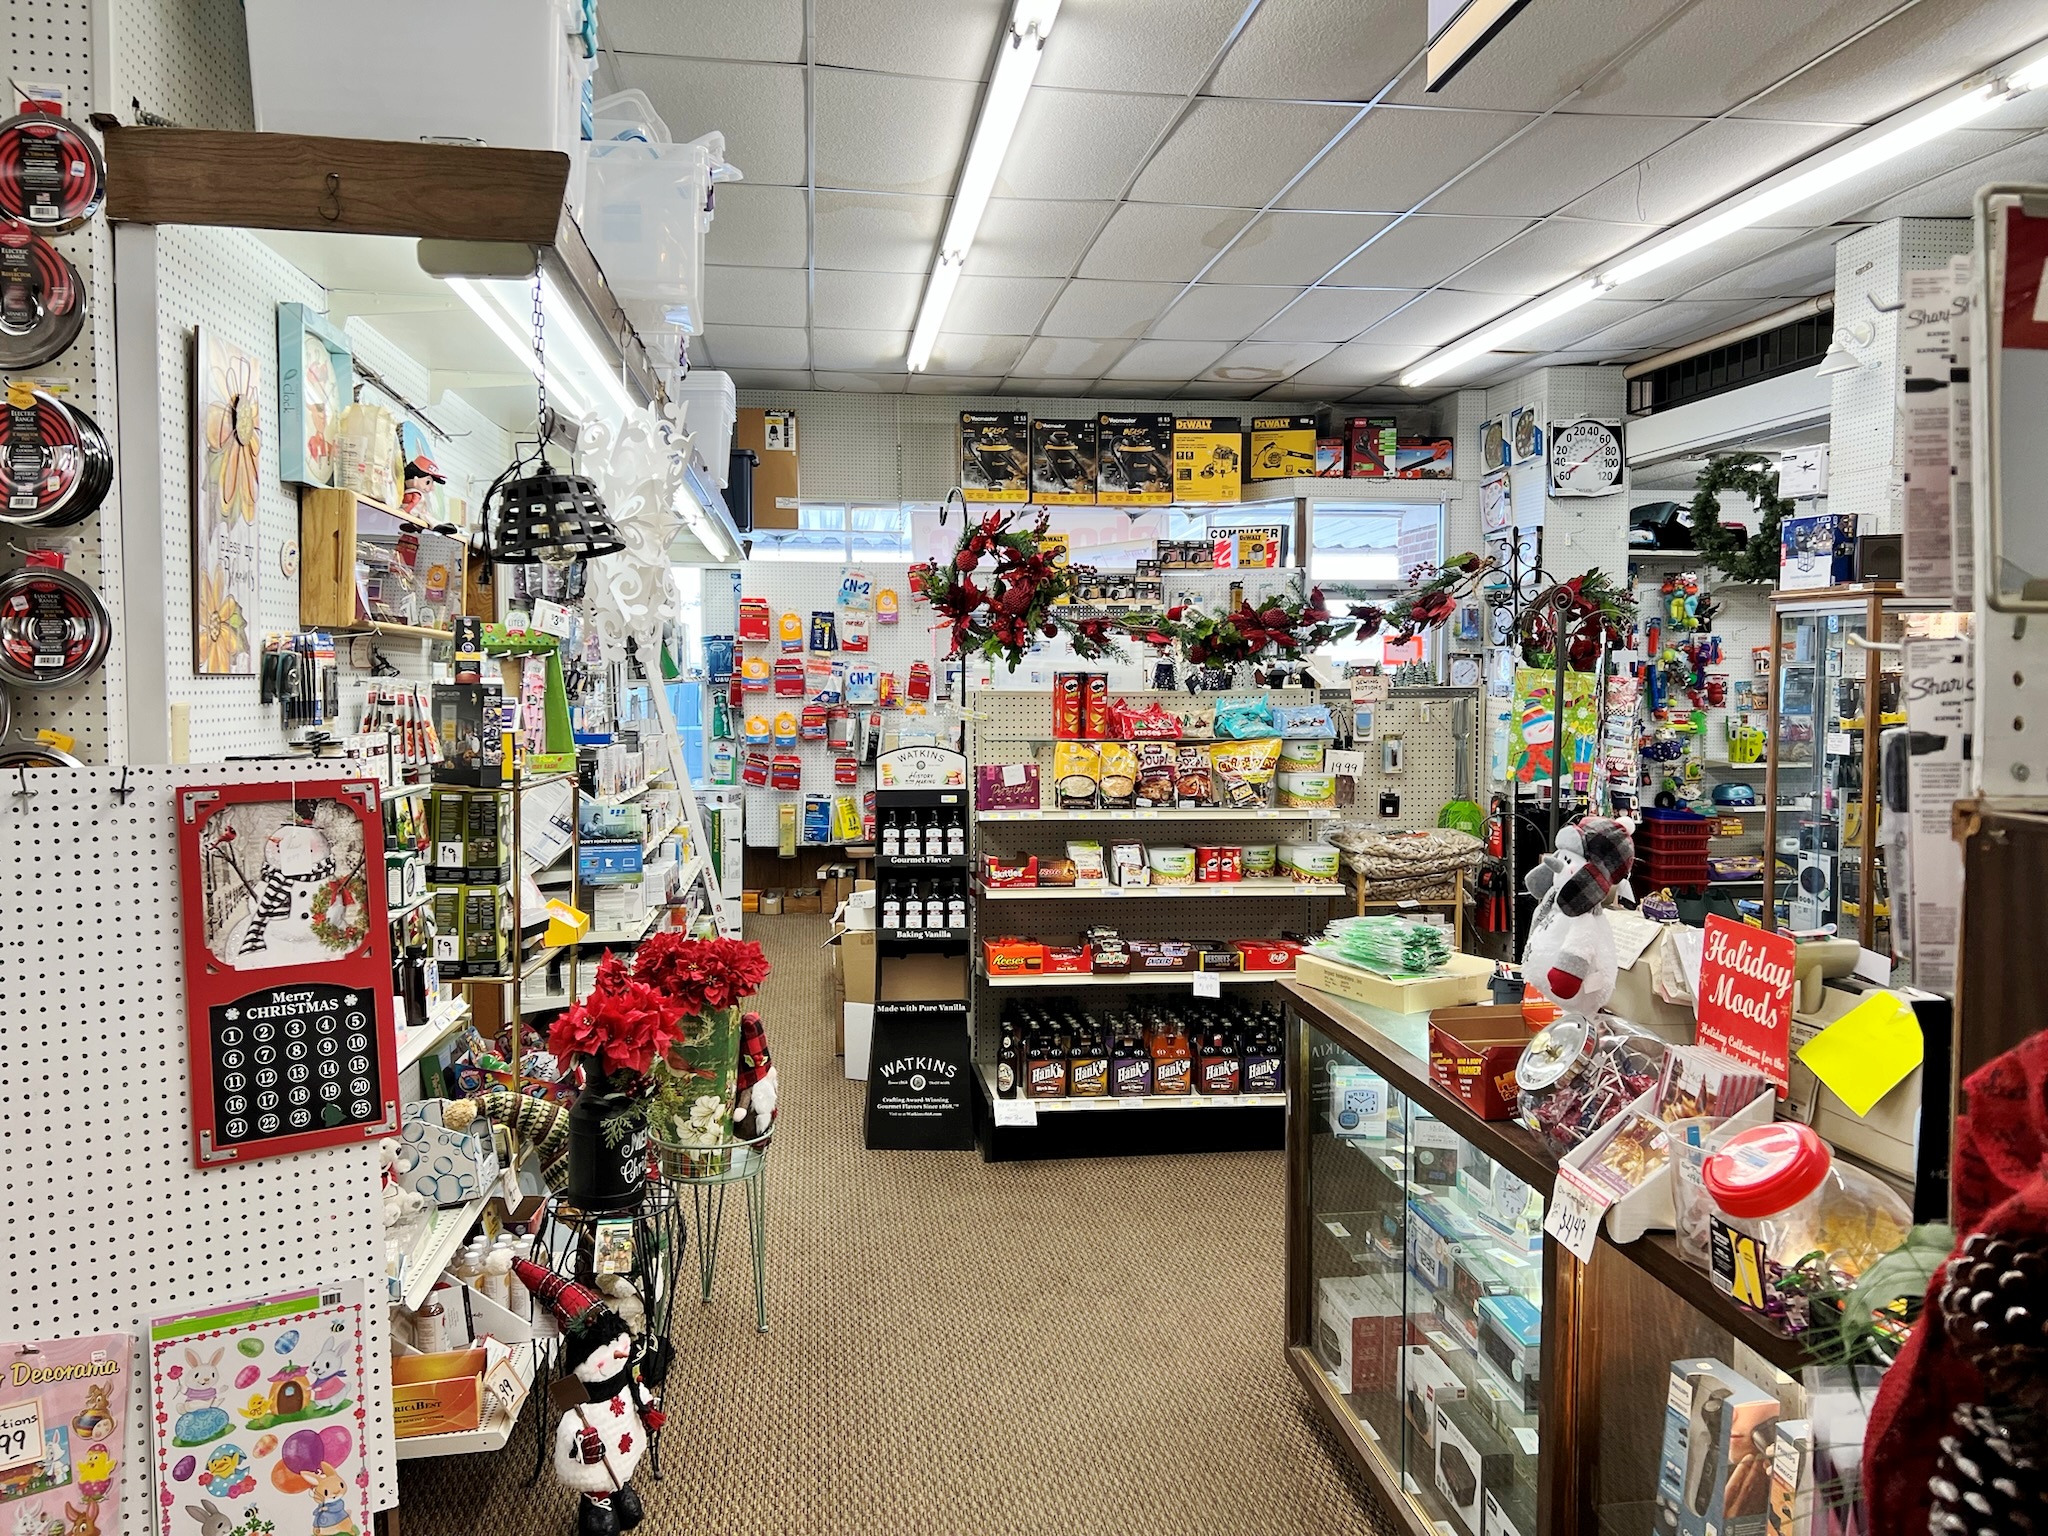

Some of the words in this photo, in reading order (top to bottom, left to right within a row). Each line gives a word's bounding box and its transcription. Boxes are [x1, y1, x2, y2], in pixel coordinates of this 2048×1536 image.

[1574, 427, 1586, 436] 20
[1587, 426, 1598, 436] 40
[1566, 434, 1572, 442] 0
[1600, 434, 1611, 443] 60
[1605, 447, 1616, 456] 80
[1604, 459, 1618, 468] 100
[1598, 472, 1612, 480] 120
[843, 578, 871, 594] CN-2
[849, 672, 874, 685] CN-1
[897, 750, 946, 763] WATKINS
[891, 856, 925, 864] Gourmet
[926, 856, 952, 864] Flavor
[992, 868, 1023, 880] Skittles
[897, 931, 924, 939] Baking
[925, 930, 952, 938] Vanilla
[1148, 957, 1172, 965] SNICKERS
[1204, 954, 1231, 964] HERSHEY'S
[1704, 928, 1792, 1000] Holiday
[272, 991, 314, 1004] Merry
[1708, 974, 1778, 1030] Moods
[246, 998, 339, 1020] CHRISTMAS
[938, 1004, 966, 1012] Vanilla
[228, 1031, 236, 1042] 1
[260, 1027, 268, 1038] 2
[292, 1023, 300, 1034] 3
[322, 1020, 330, 1030] 4
[352, 1016, 360, 1026] 5
[229, 1054, 237, 1064] 6
[261, 1050, 269, 1060] 7
[292, 1046, 300, 1056] 8
[324, 1042, 332, 1052] 9
[352, 1038, 364, 1048] 10
[1700, 1022, 1727, 1046] Holiday
[1728, 1035, 1760, 1060] Collection
[1761, 1050, 1773, 1065] for
[1774, 1058, 1786, 1071] the
[880, 1056, 958, 1078] WATKINS
[1032, 1062, 1063, 1083] Hank's
[1248, 1059, 1280, 1079] Hank's
[1458, 1066, 1482, 1076] WARMER
[229, 1076, 241, 1088] 11
[260, 1072, 272, 1083] 12
[292, 1068, 304, 1078] 13
[324, 1064, 335, 1074] 14
[352, 1060, 364, 1070] 15
[230, 1100, 242, 1110] 16
[262, 1095, 274, 1106] 17
[294, 1090, 306, 1100] 18
[325, 1086, 336, 1096] 19
[354, 1082, 366, 1092] 20
[231, 1122, 243, 1133] 21
[262, 1118, 275, 1128] 22
[294, 1112, 306, 1123] 23
[356, 1104, 368, 1114] 25
[10, 1360, 120, 1388] Decorama
